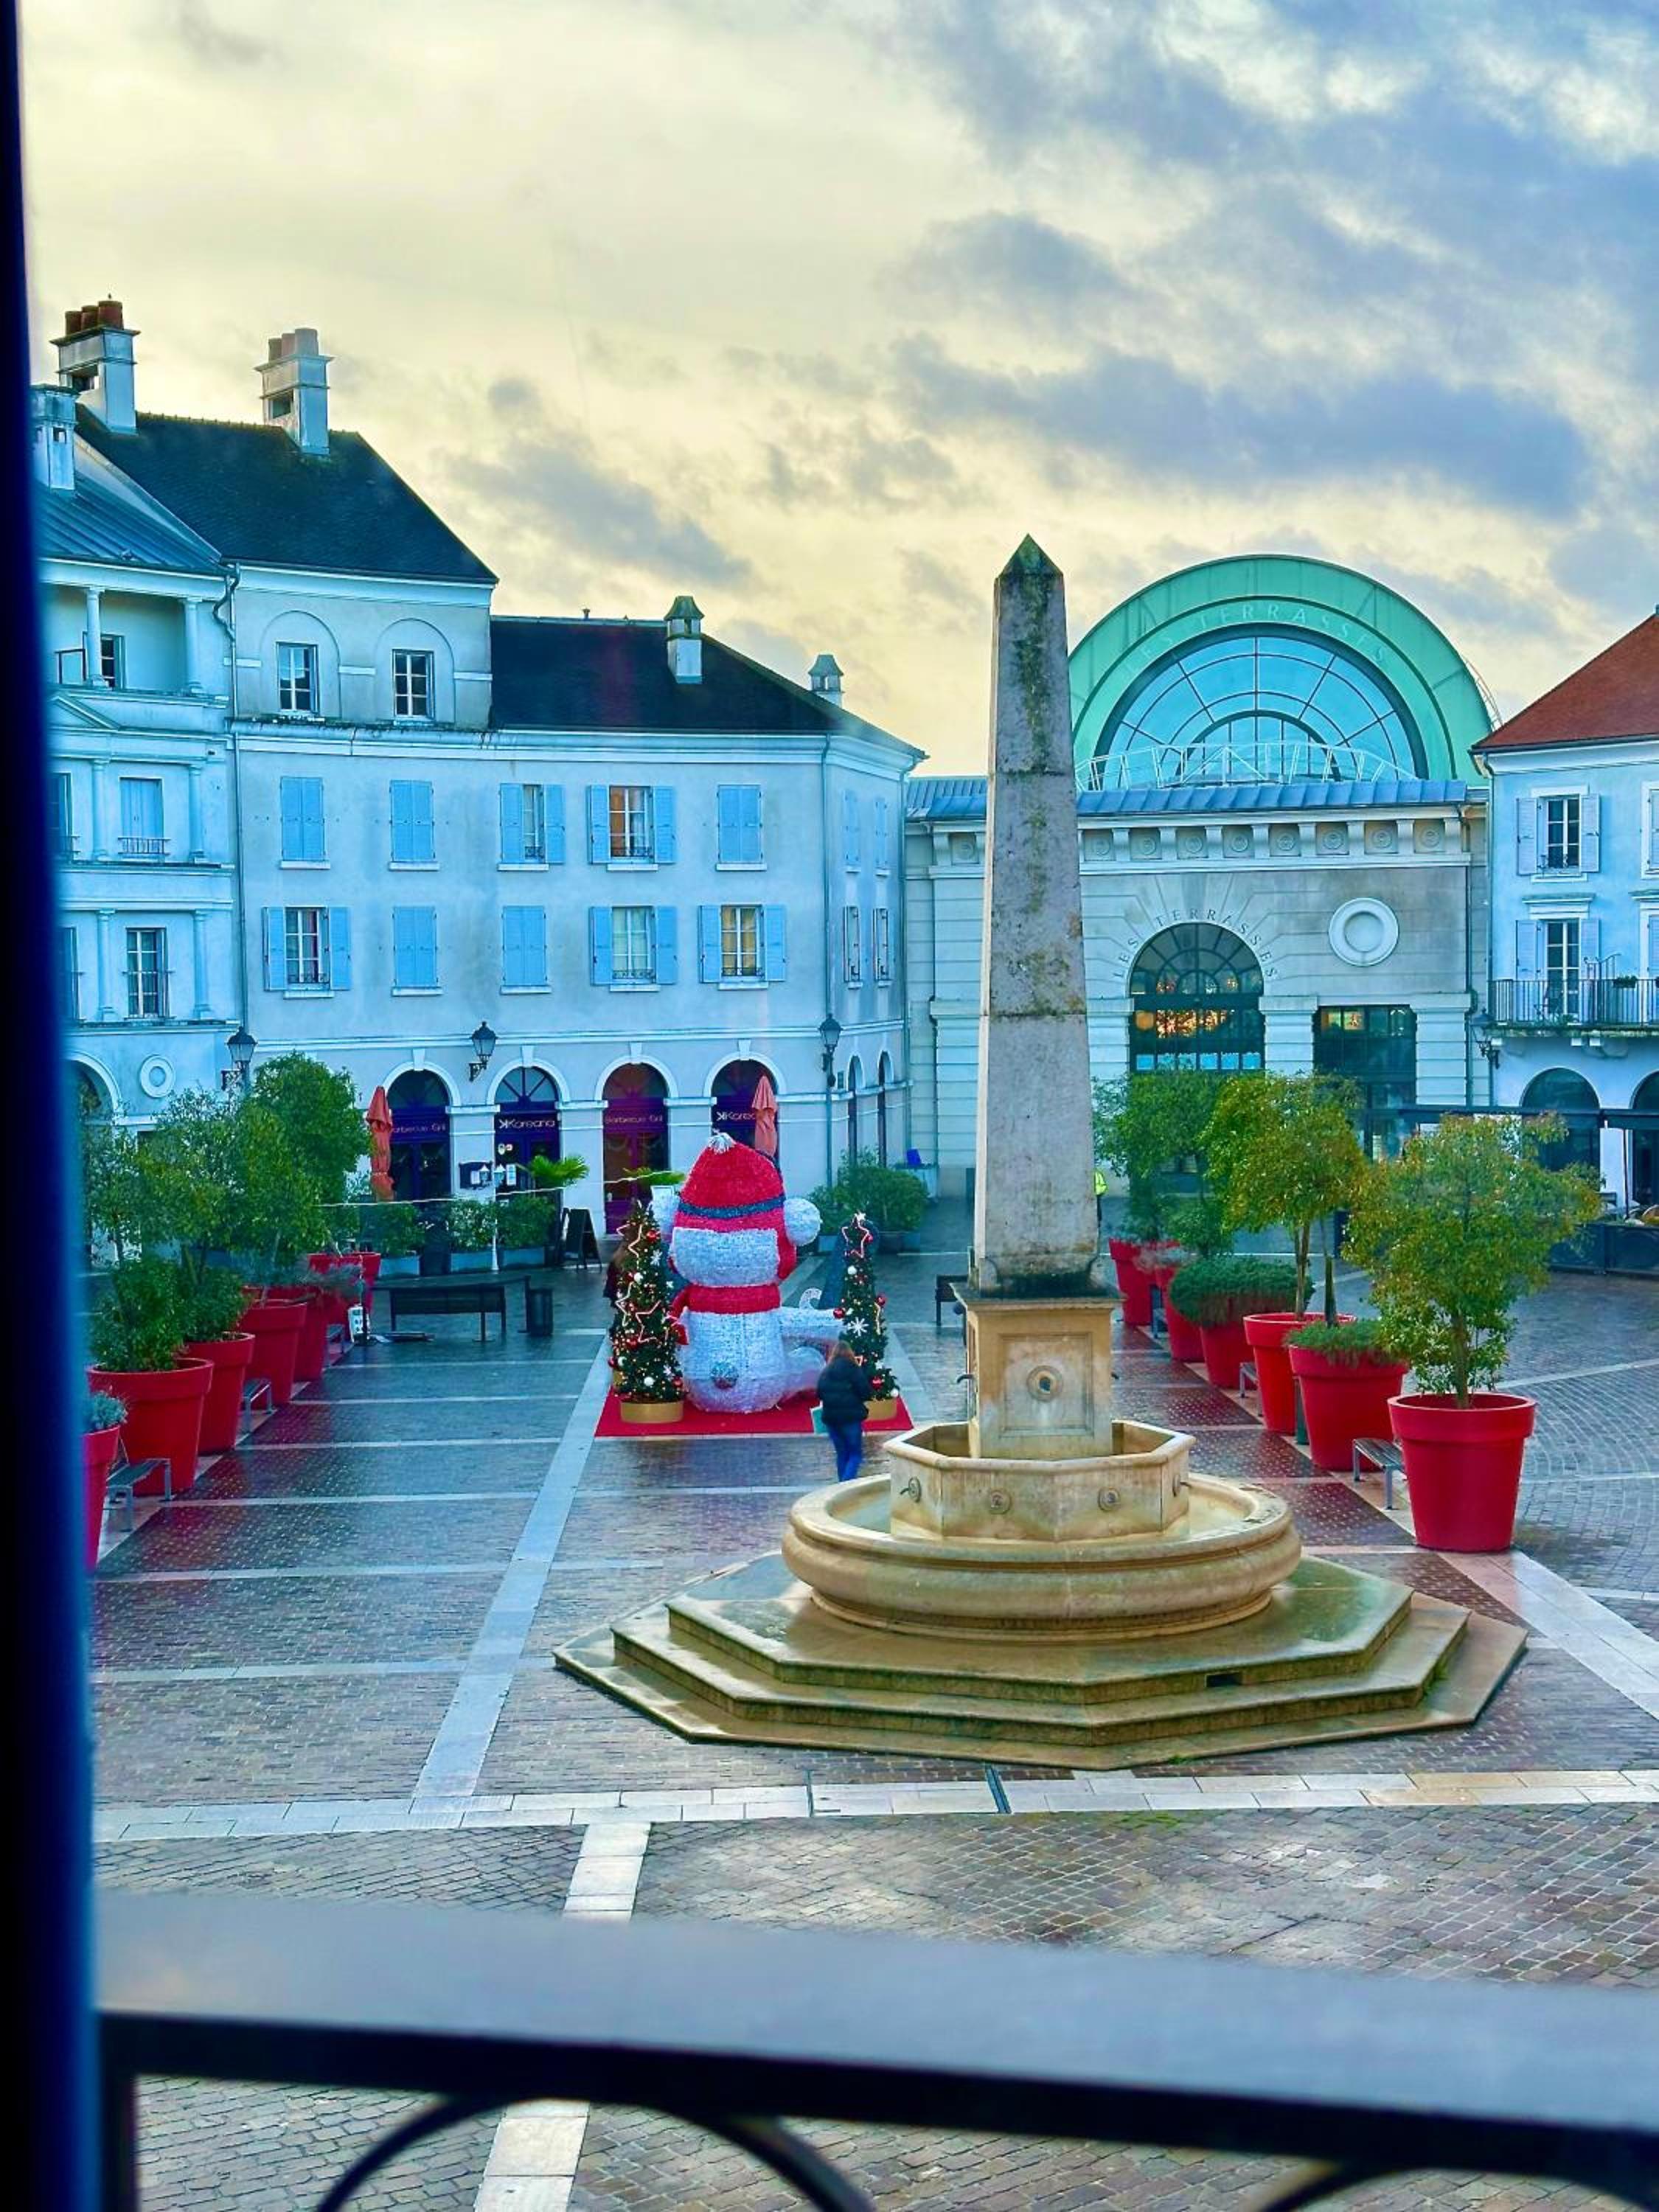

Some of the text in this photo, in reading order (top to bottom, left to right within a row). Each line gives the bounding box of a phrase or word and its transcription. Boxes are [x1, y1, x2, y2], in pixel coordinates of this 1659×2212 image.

[1127, 605, 1387, 672] LES TERRASSES
[1113, 908, 1278, 978] LES TERRASSES
[392, 1124, 428, 1133] arbecue
